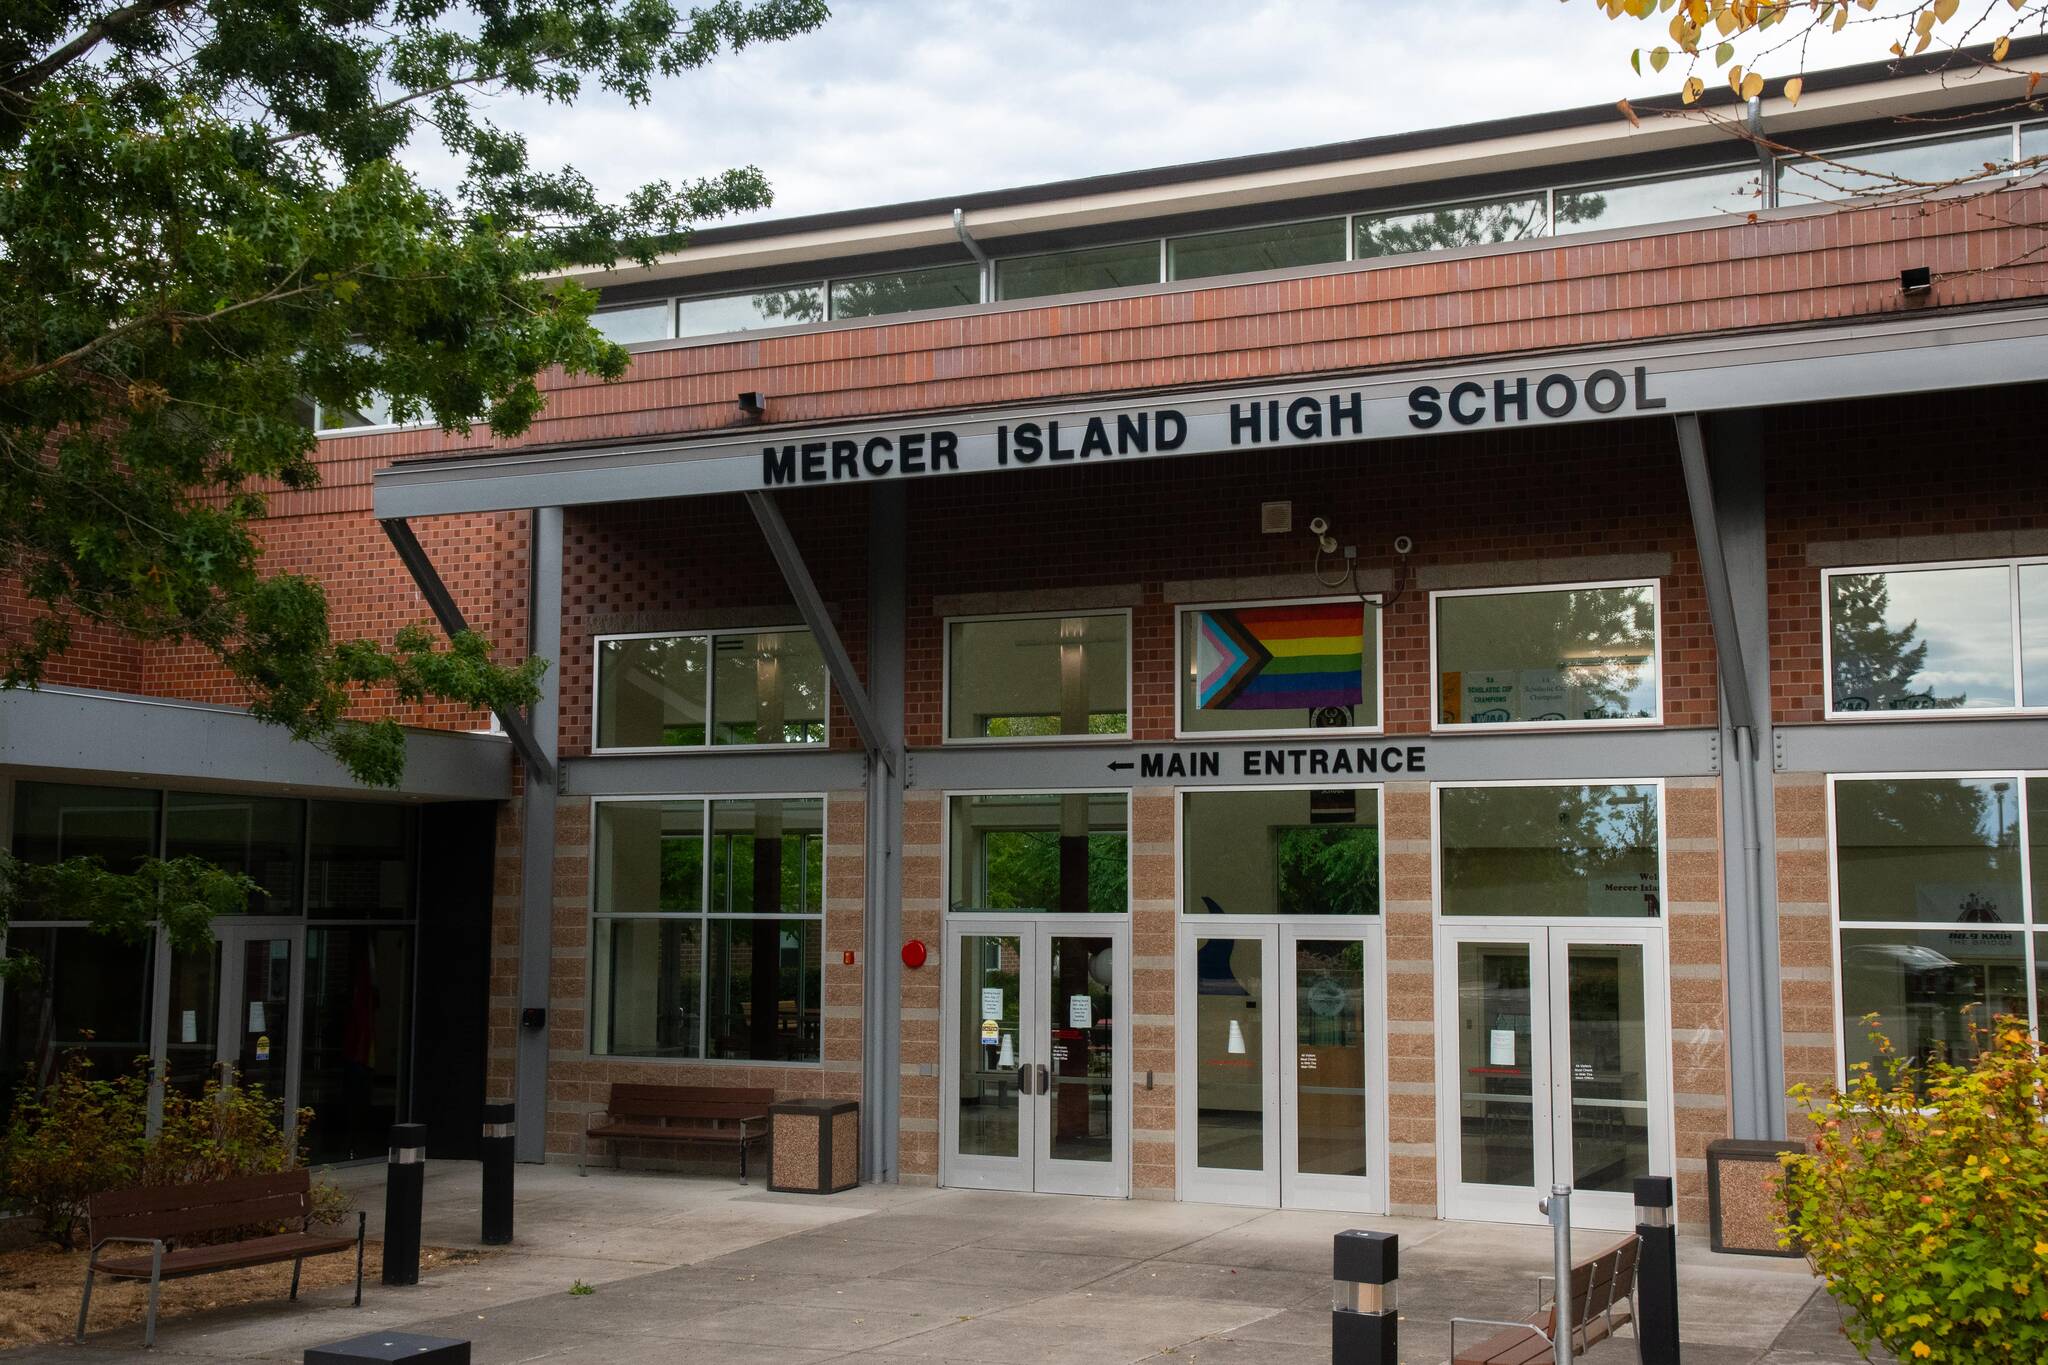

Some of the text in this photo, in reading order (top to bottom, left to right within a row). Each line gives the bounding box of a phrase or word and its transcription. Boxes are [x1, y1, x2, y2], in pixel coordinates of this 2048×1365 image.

[763, 366, 1667, 485] MERCER ISLAND HIGH SCHOOL
[1141, 746, 1426, 777] MAIN ENTRANCE
[1604, 883, 1638, 892] Mercer
